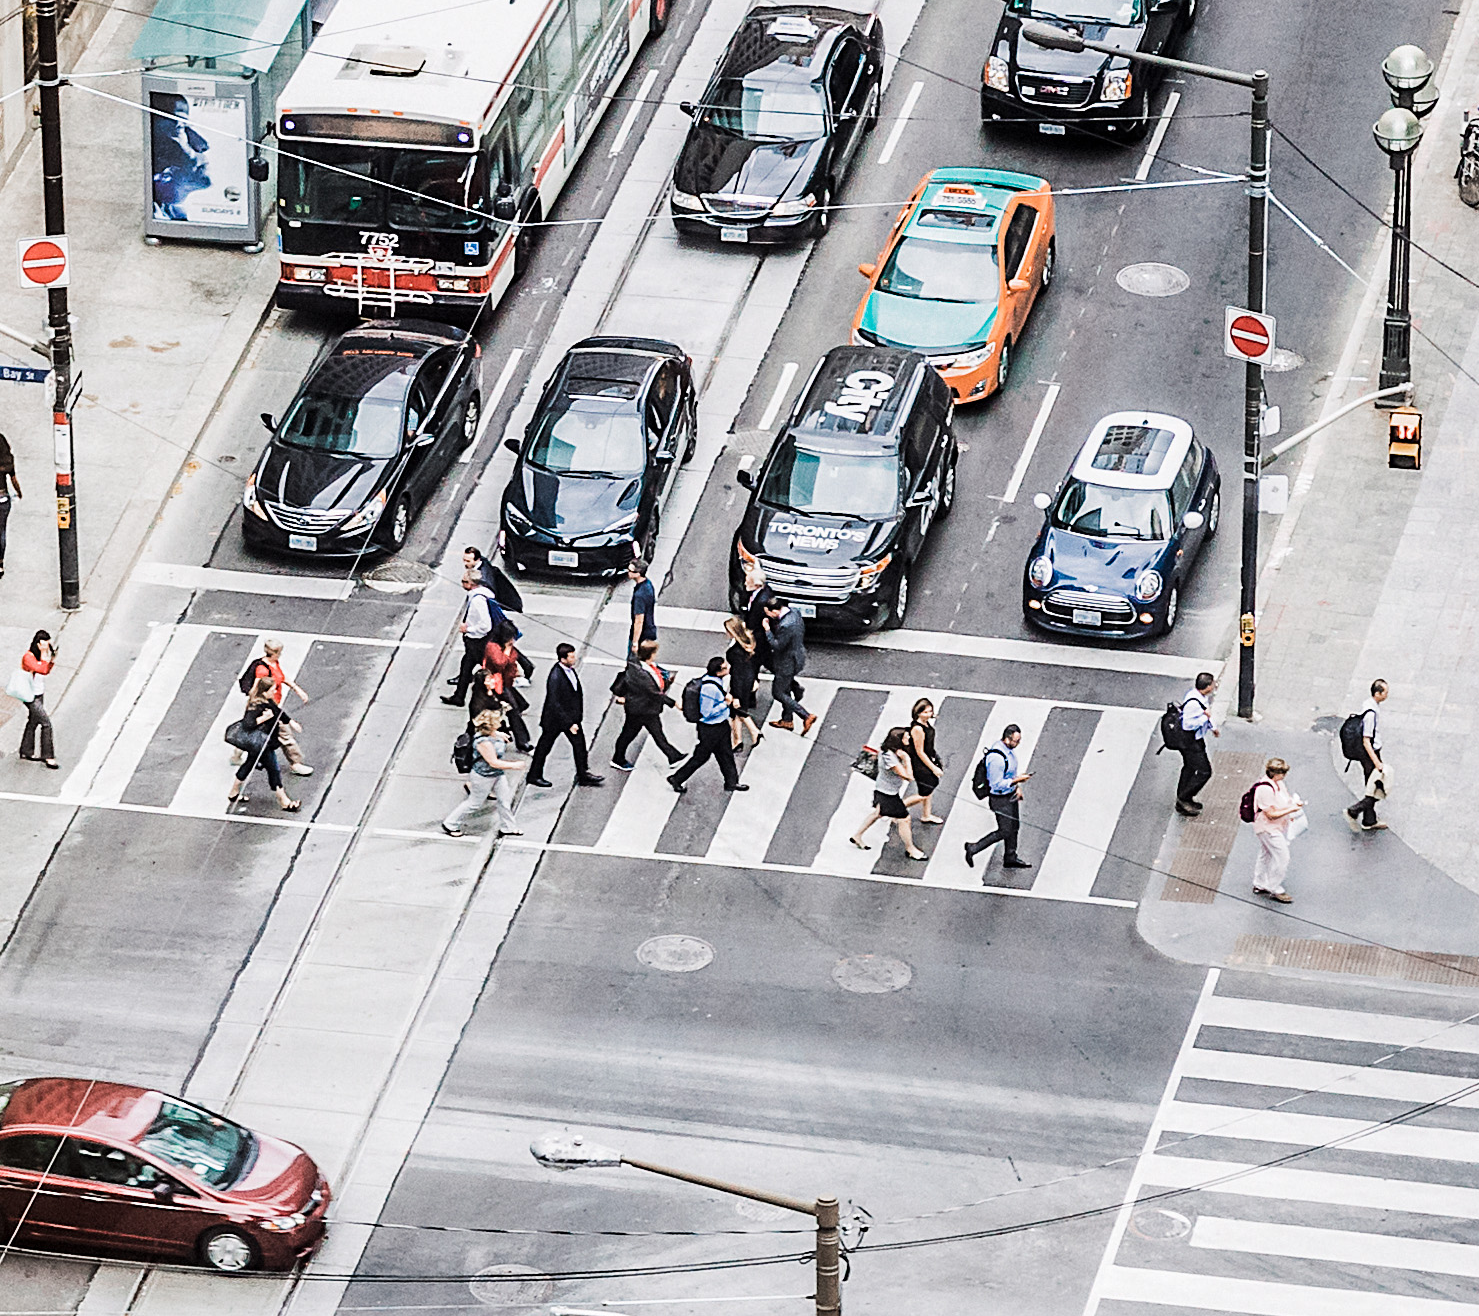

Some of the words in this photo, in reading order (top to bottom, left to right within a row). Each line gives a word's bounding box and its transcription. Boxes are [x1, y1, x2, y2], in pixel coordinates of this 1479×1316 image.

[359, 231, 399, 247] 7752
[3, 368, 22, 381] Bay
[824, 370, 896, 424] City
[768, 522, 867, 542] TORONTO'S
[787, 535, 840, 550] NEWS
